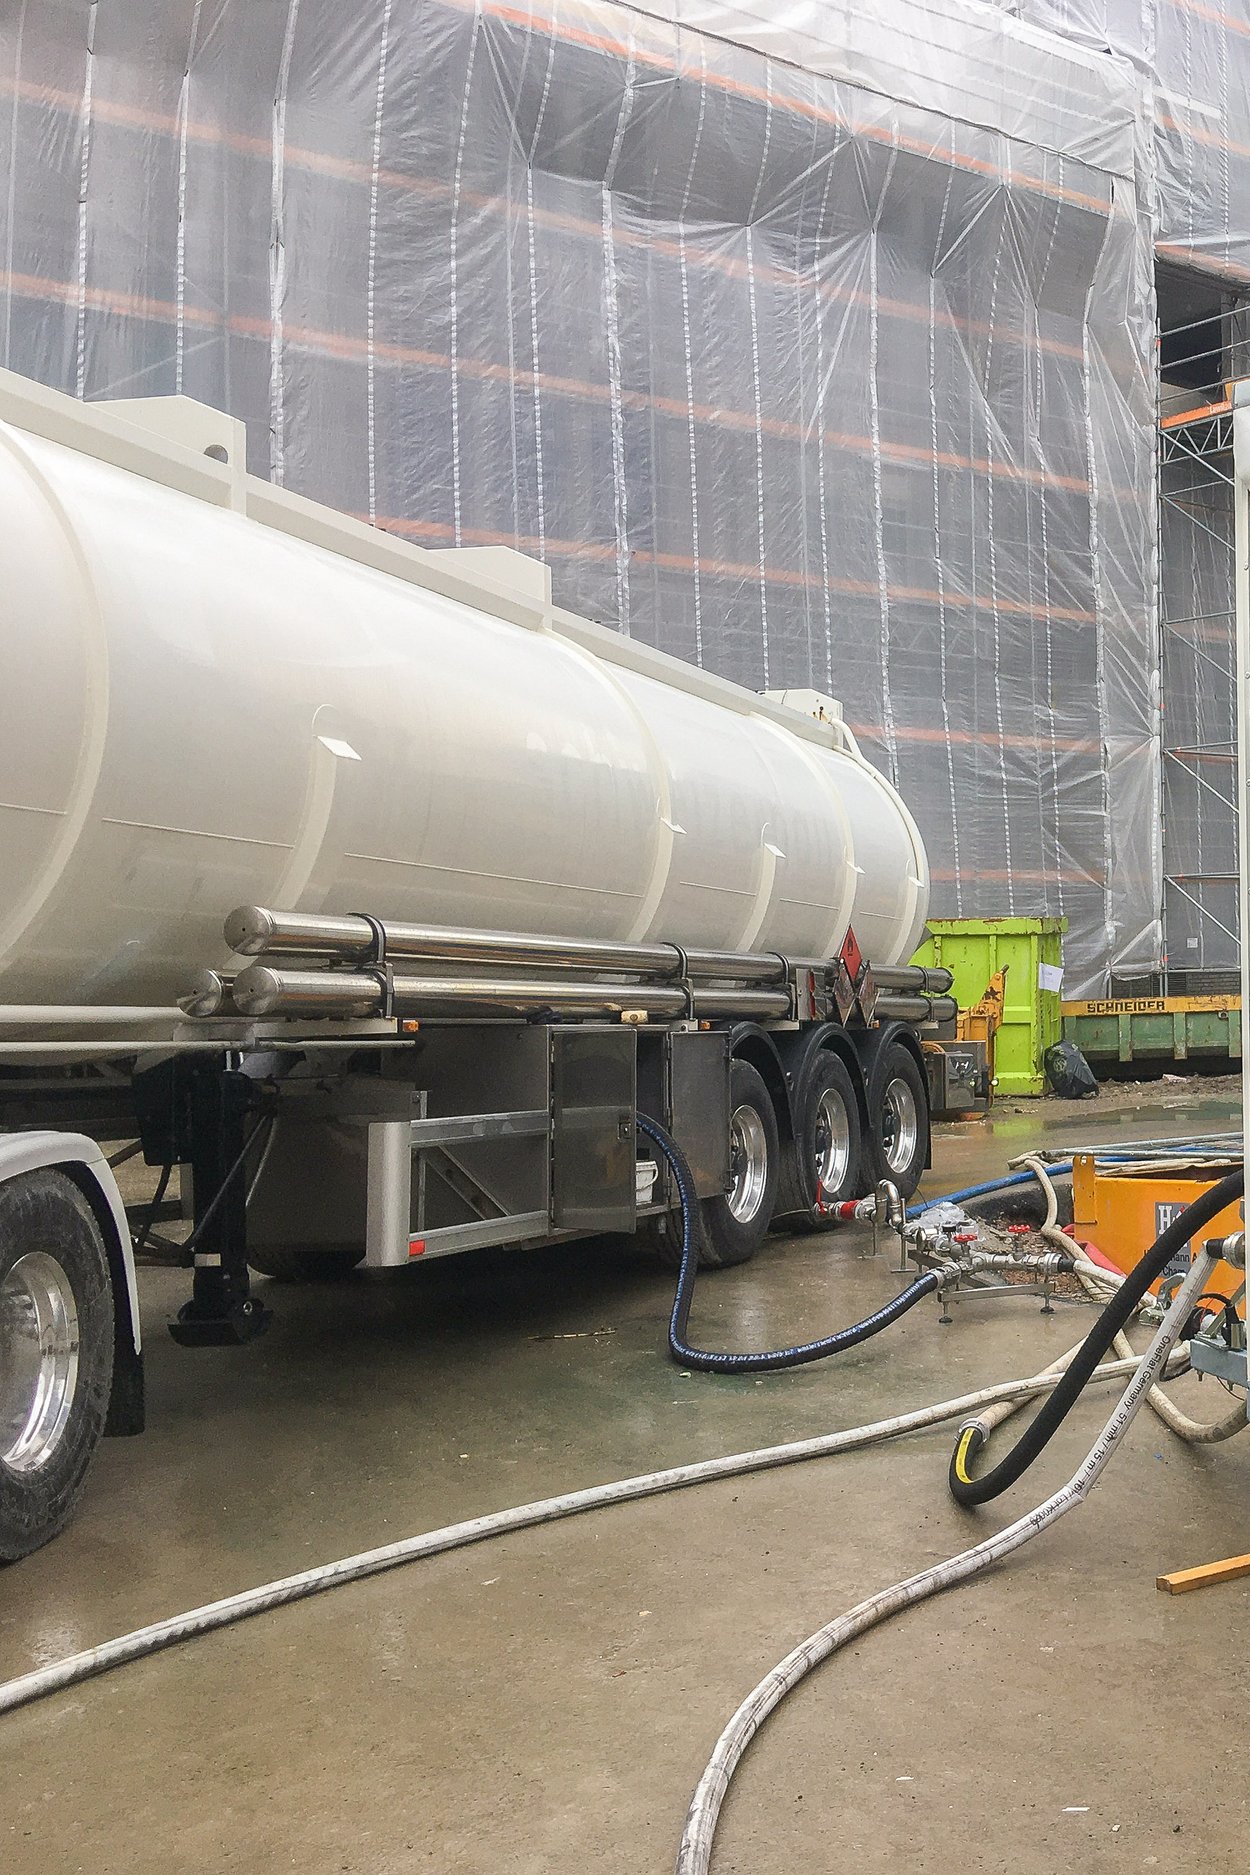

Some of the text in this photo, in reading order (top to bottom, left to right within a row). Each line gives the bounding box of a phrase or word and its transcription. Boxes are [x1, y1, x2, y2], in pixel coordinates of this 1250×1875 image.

[1087, 1000, 1165, 1013] SCHNEIDER
[1147, 1335, 1171, 1372] OneFlat
[1123, 1370, 1152, 1411] Germany
